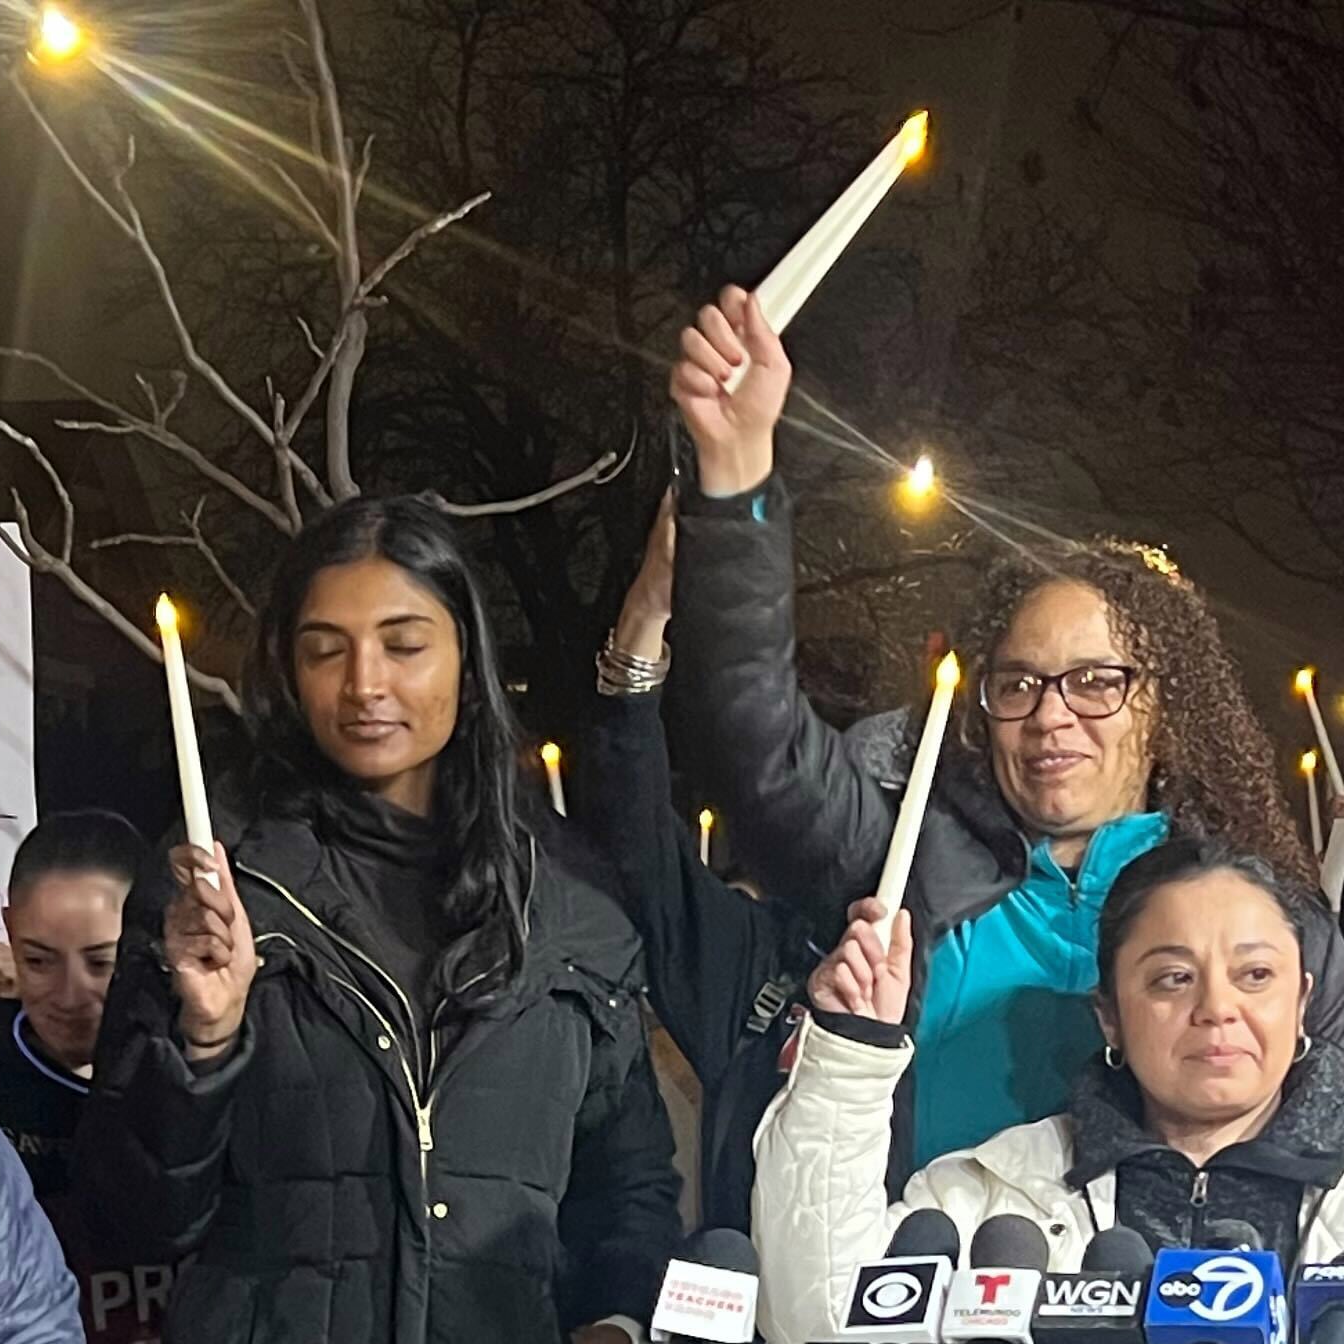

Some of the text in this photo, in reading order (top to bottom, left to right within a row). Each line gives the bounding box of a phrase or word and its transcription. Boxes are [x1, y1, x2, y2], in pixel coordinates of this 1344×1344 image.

[1046, 1280, 1141, 1306] WGN
[1159, 1256, 1264, 1321] abc 7
